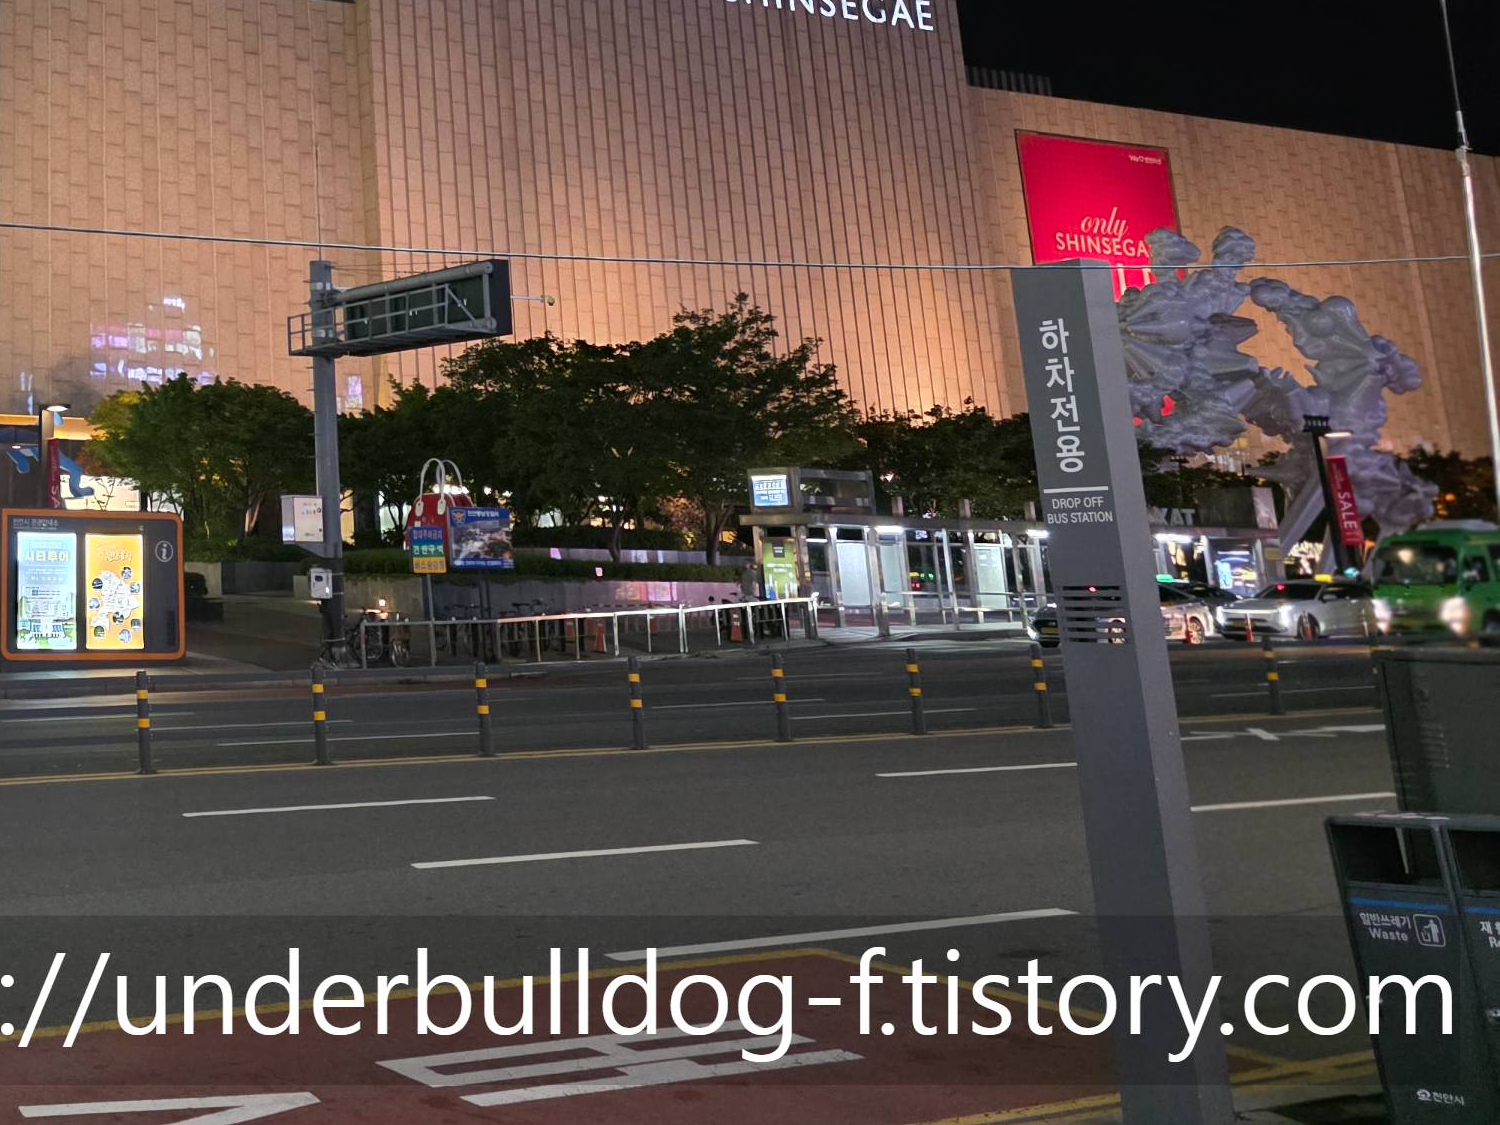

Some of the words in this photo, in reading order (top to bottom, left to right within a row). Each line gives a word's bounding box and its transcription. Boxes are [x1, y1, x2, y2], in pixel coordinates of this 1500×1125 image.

[1081, 206, 1128, 242] only
[1055, 231, 1150, 259] SHINSEGA
[1039, 317, 1086, 473] 하차전용
[1051, 498, 1081, 510] DROP
[1083, 496, 1105, 508] OFF
[1337, 491, 1358, 530] SALE
[1046, 512, 1069, 525] BUS
[1070, 510, 1114, 524] STATION
[25, 550, 70, 562] 시티투어
[414, 559, 445, 571] 버스승강장
[1359, 912, 1412, 930] 일반쓰레기
[1368, 927, 1409, 942] Waste
